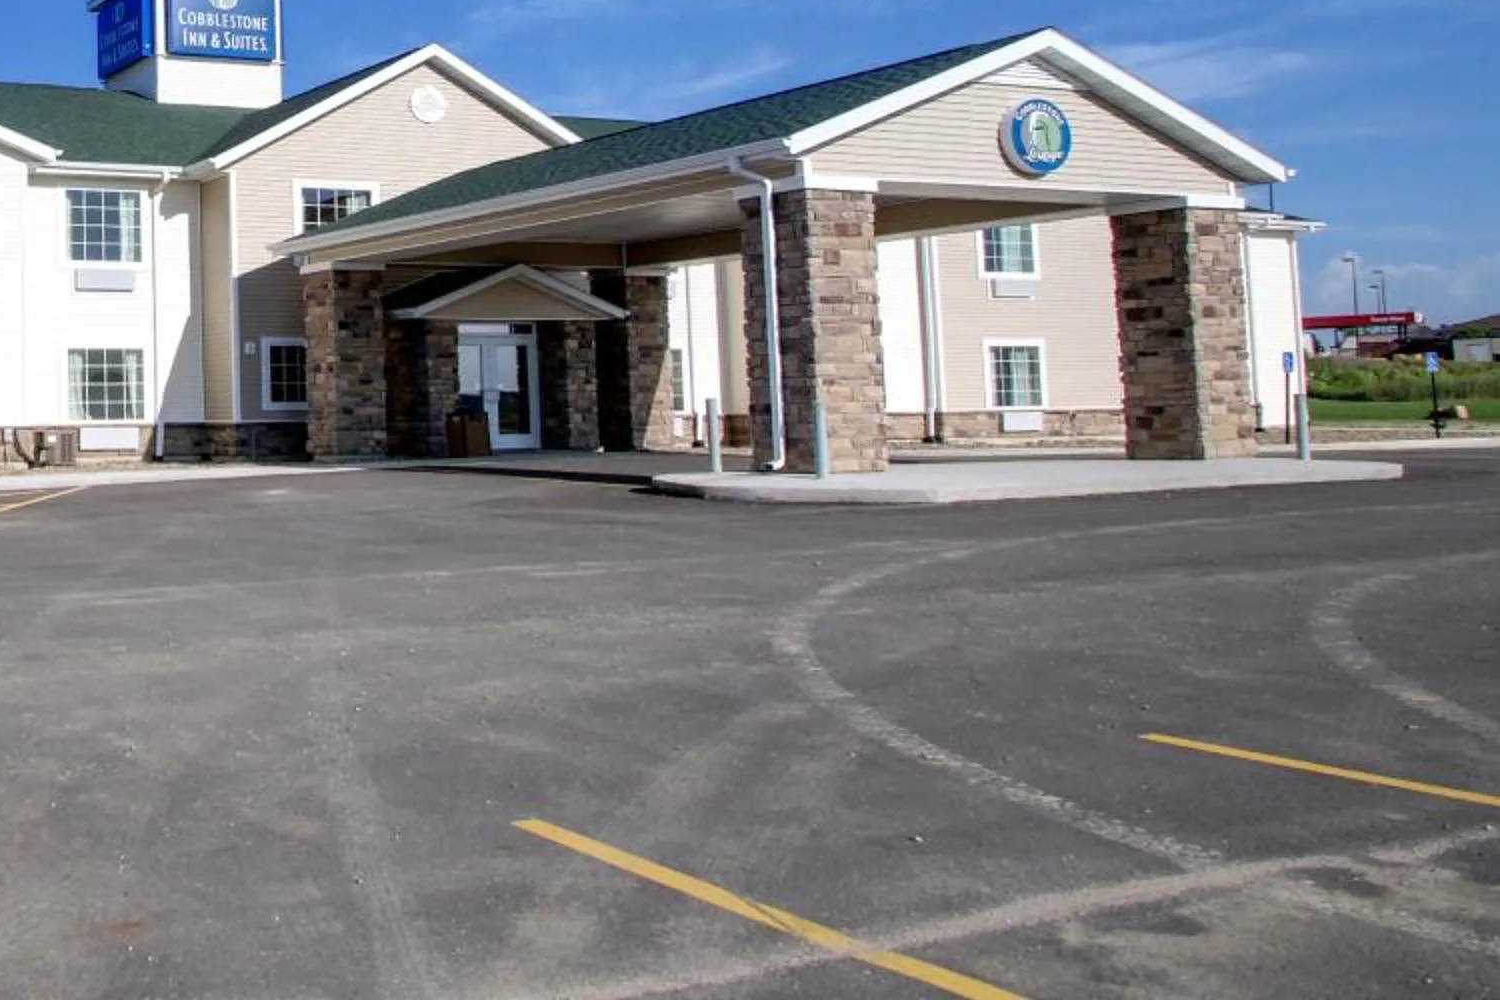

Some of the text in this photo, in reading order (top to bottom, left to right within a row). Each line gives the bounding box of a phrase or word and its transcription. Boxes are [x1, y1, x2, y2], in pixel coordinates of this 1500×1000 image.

[178, 7, 269, 32] COBBLESTONE
[183, 28, 267, 51] INN & SUITES
